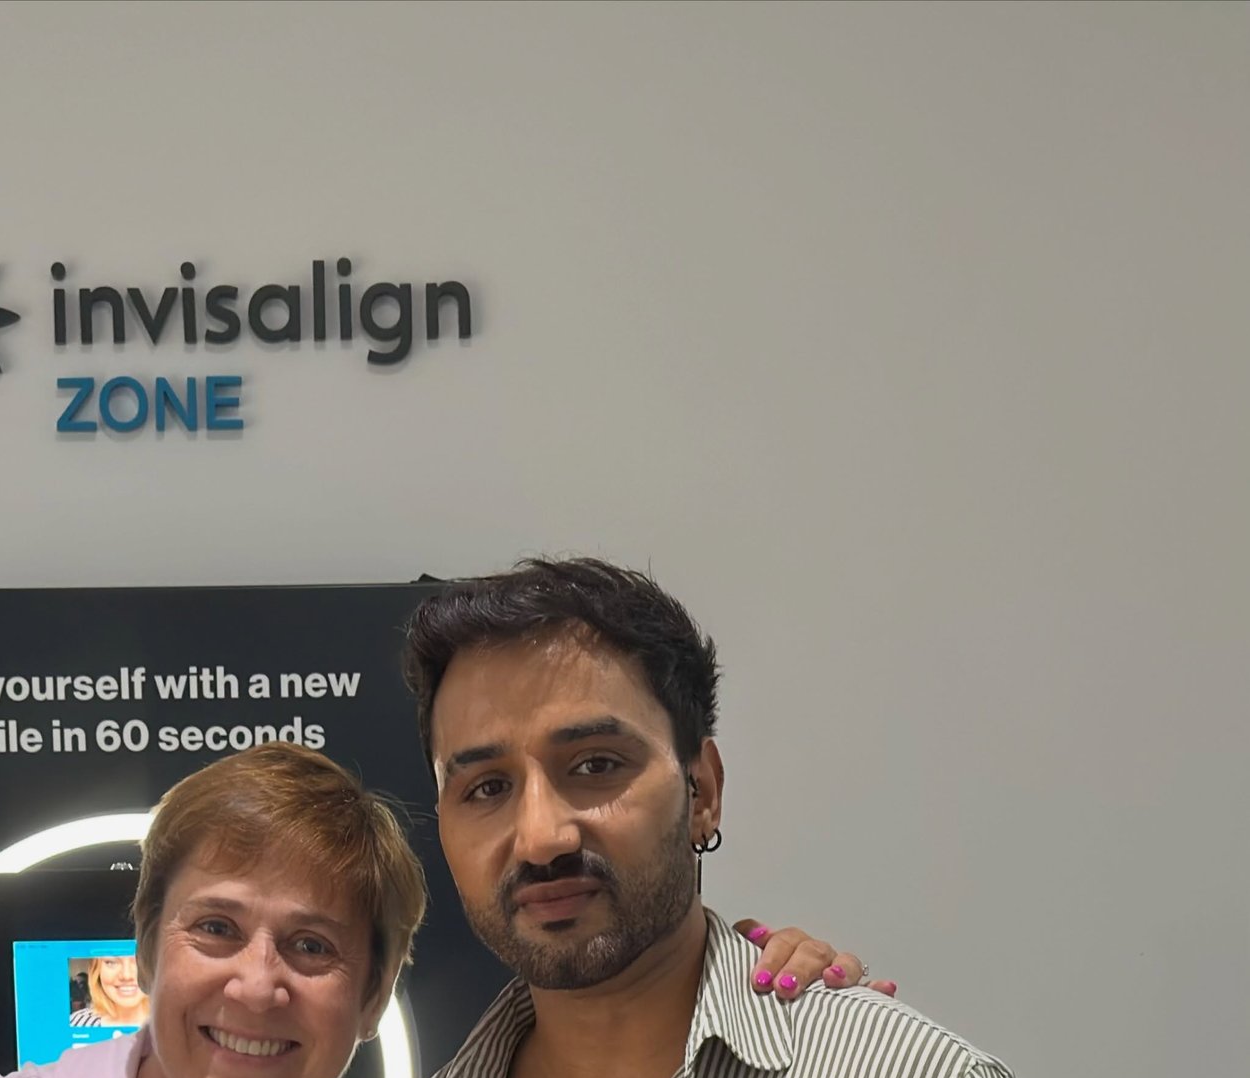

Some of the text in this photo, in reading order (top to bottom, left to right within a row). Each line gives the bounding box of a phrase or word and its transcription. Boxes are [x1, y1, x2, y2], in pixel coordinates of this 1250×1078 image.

[50, 257, 472, 364] invisalign
[56, 375, 244, 432] ZONE
[154, 666, 239, 699] with
[248, 673, 271, 698] a
[279, 672, 361, 698] new
[52, 719, 87, 752] in
[95, 719, 149, 752] 60
[157, 717, 326, 752] seconds
